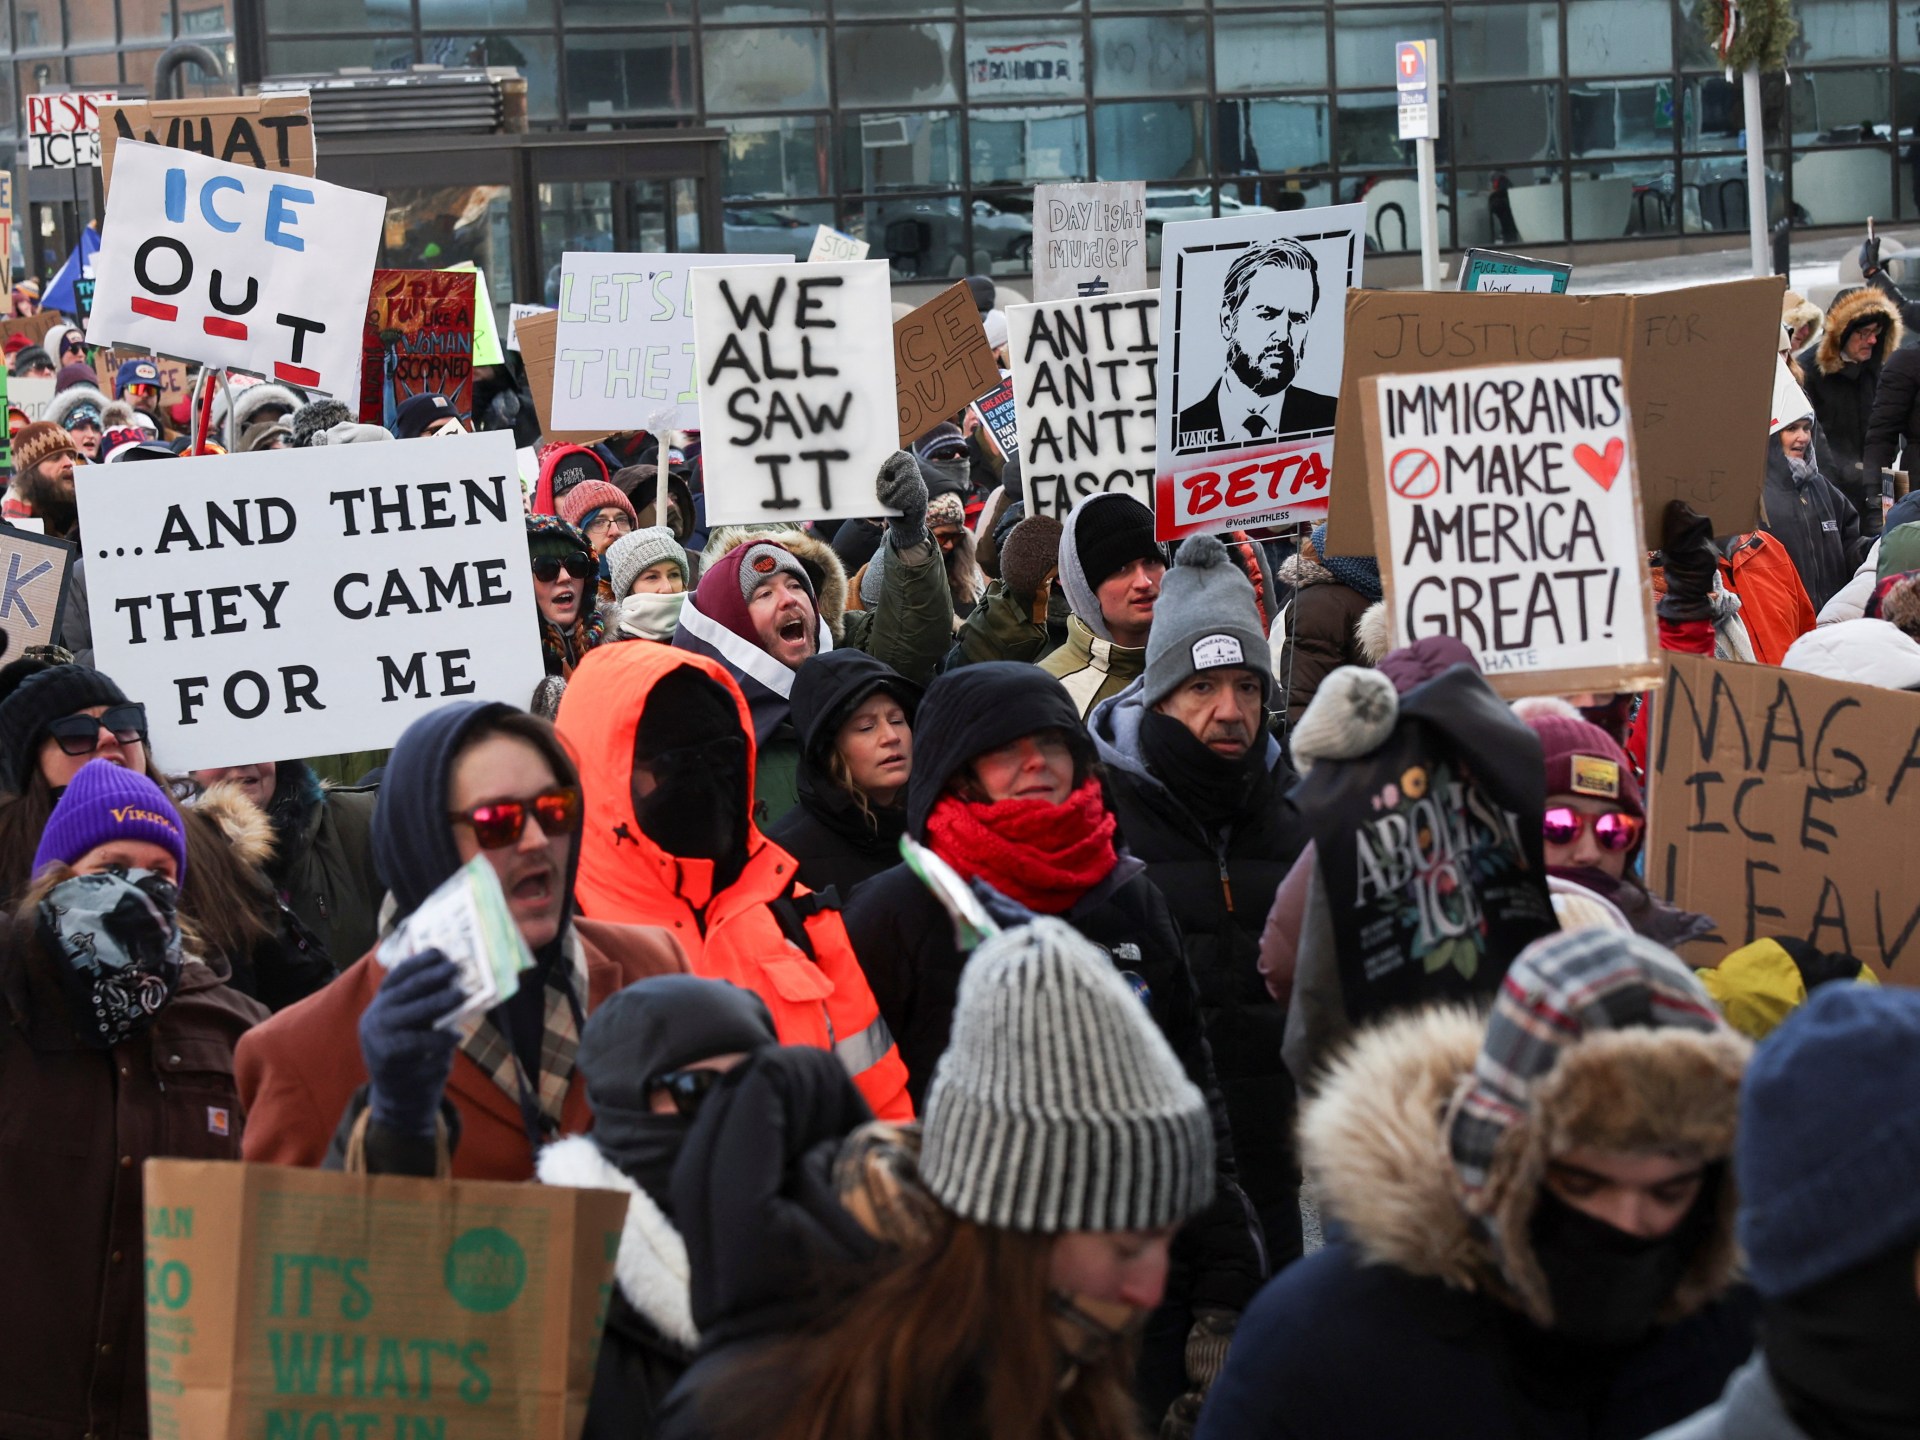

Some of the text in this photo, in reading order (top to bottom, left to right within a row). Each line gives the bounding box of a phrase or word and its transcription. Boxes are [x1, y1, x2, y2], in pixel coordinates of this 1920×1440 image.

[1401, 93, 1424, 104] Route
[30, 132, 92, 168] ICE
[165, 168, 315, 252] ICE
[820, 235, 860, 260] STOP
[1500, 265, 1518, 274] ICE
[134, 236, 326, 363] OUT
[560, 271, 675, 322] LET'S
[720, 277, 843, 331] WE
[401, 329, 471, 354] WOMAN
[708, 331, 840, 385] ALL
[898, 292, 978, 380] CE
[1024, 300, 1160, 364] ANTI
[1374, 312, 1707, 360] JUSTICE FOR
[396, 356, 471, 381] SCORNED
[728, 387, 852, 446] SAW
[980, 388, 1013, 411] GREATES
[1387, 374, 1622, 438] IMMIGRANTS
[1181, 429, 1218, 446] VANCE
[755, 449, 849, 511] IT
[1182, 452, 1331, 516] BETA
[1445, 442, 1570, 497] MAKE
[330, 476, 507, 537] THEN
[1225, 511, 1290, 529] @VoteRUTHLESS
[1404, 499, 1604, 566] AMERICA
[114, 558, 513, 645] THEY CAME
[1406, 567, 1620, 651] GREAT!
[173, 648, 477, 726] FOR ME
[1484, 650, 1539, 671] HATE
[1685, 771, 1838, 854] ICE
[268, 1252, 373, 1322] IT'S
[267, 1330, 492, 1405] WHAT'S
